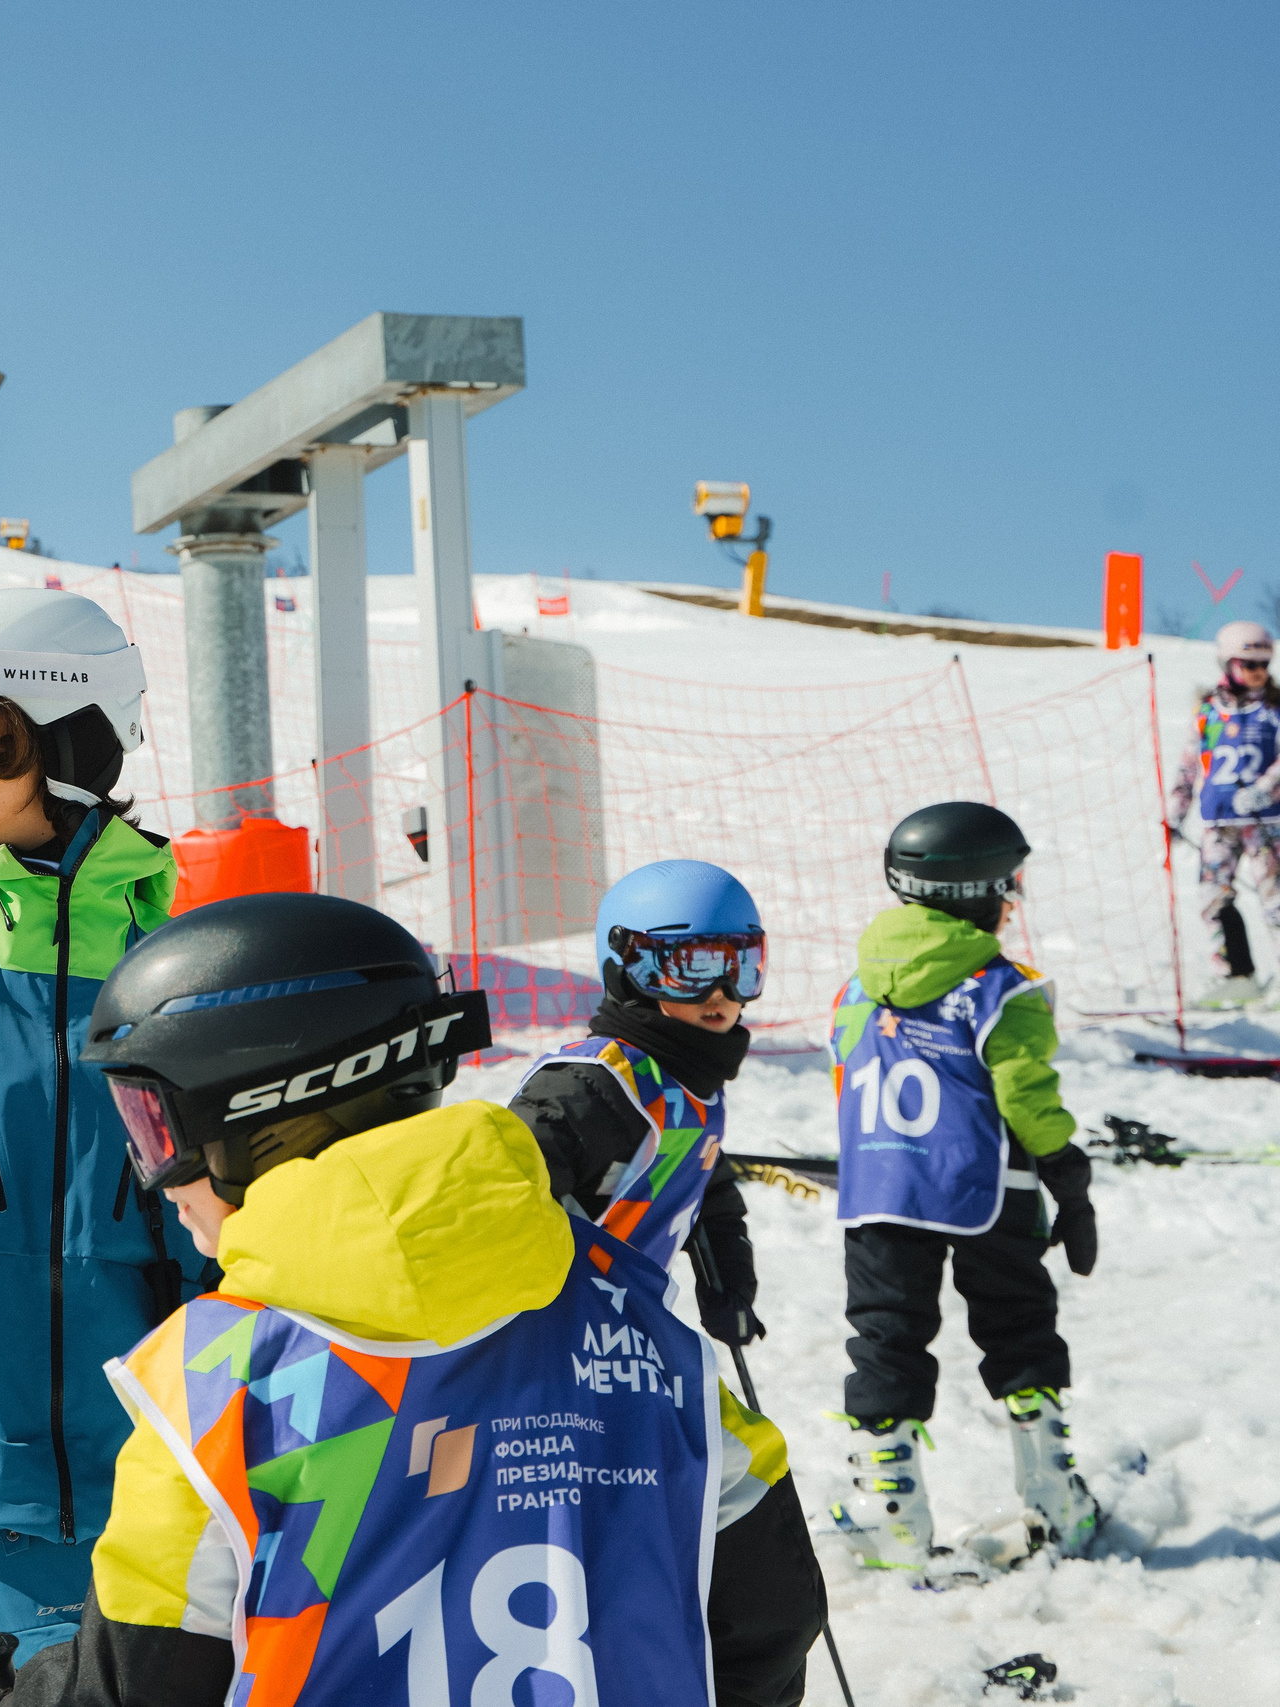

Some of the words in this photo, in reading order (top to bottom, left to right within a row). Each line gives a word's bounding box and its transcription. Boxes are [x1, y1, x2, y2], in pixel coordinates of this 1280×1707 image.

[3, 668, 89, 683] WHITELAB
[1210, 744, 1264, 786] 22
[223, 1011, 465, 1123] SCOTT
[850, 1056, 941, 1138] 10
[583, 1321, 666, 1371] ЛИГА
[491, 1417, 522, 1433] ПРИ
[494, 1435, 575, 1459] ФОНДА
[36, 1602, 86, 1617] Drag
[374, 1543, 600, 1707] 18
